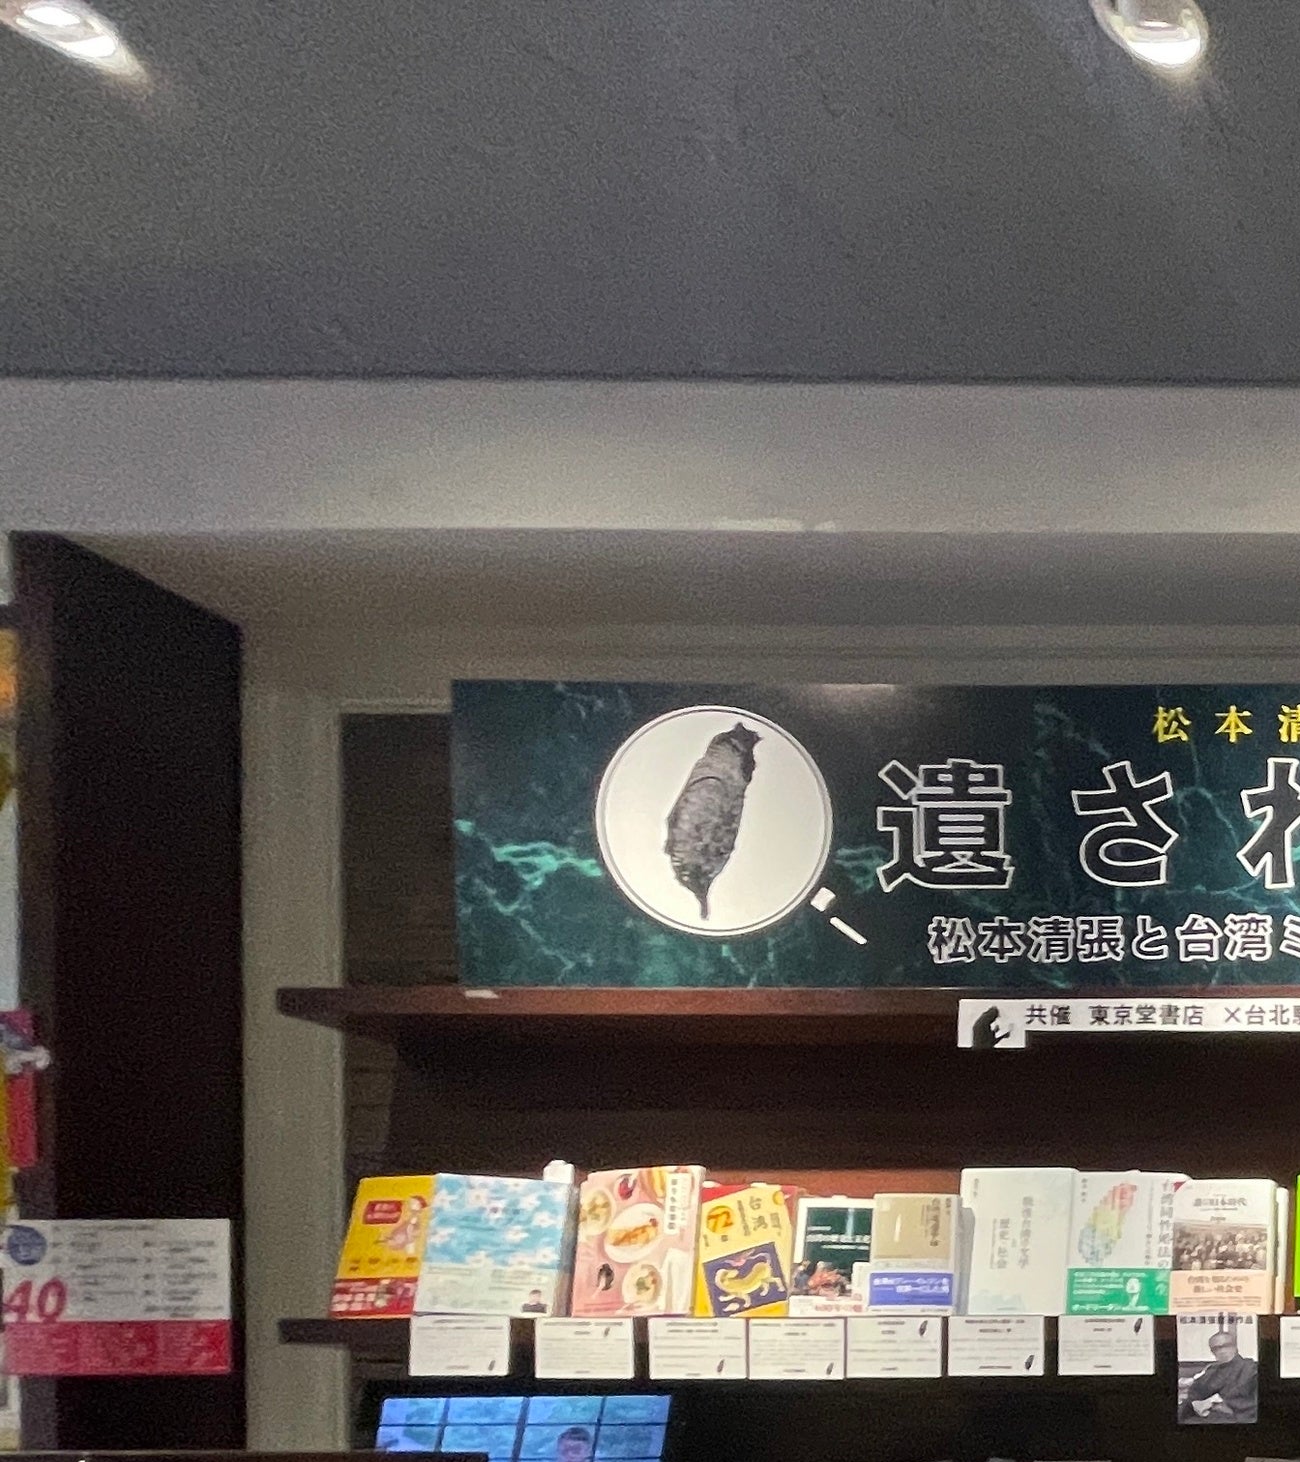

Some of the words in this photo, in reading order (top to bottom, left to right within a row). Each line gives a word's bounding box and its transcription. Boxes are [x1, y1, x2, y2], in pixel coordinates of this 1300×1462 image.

[1025, 1004, 1071, 1027] 共催
[1089, 1004, 1204, 1027] 東京堂書店
